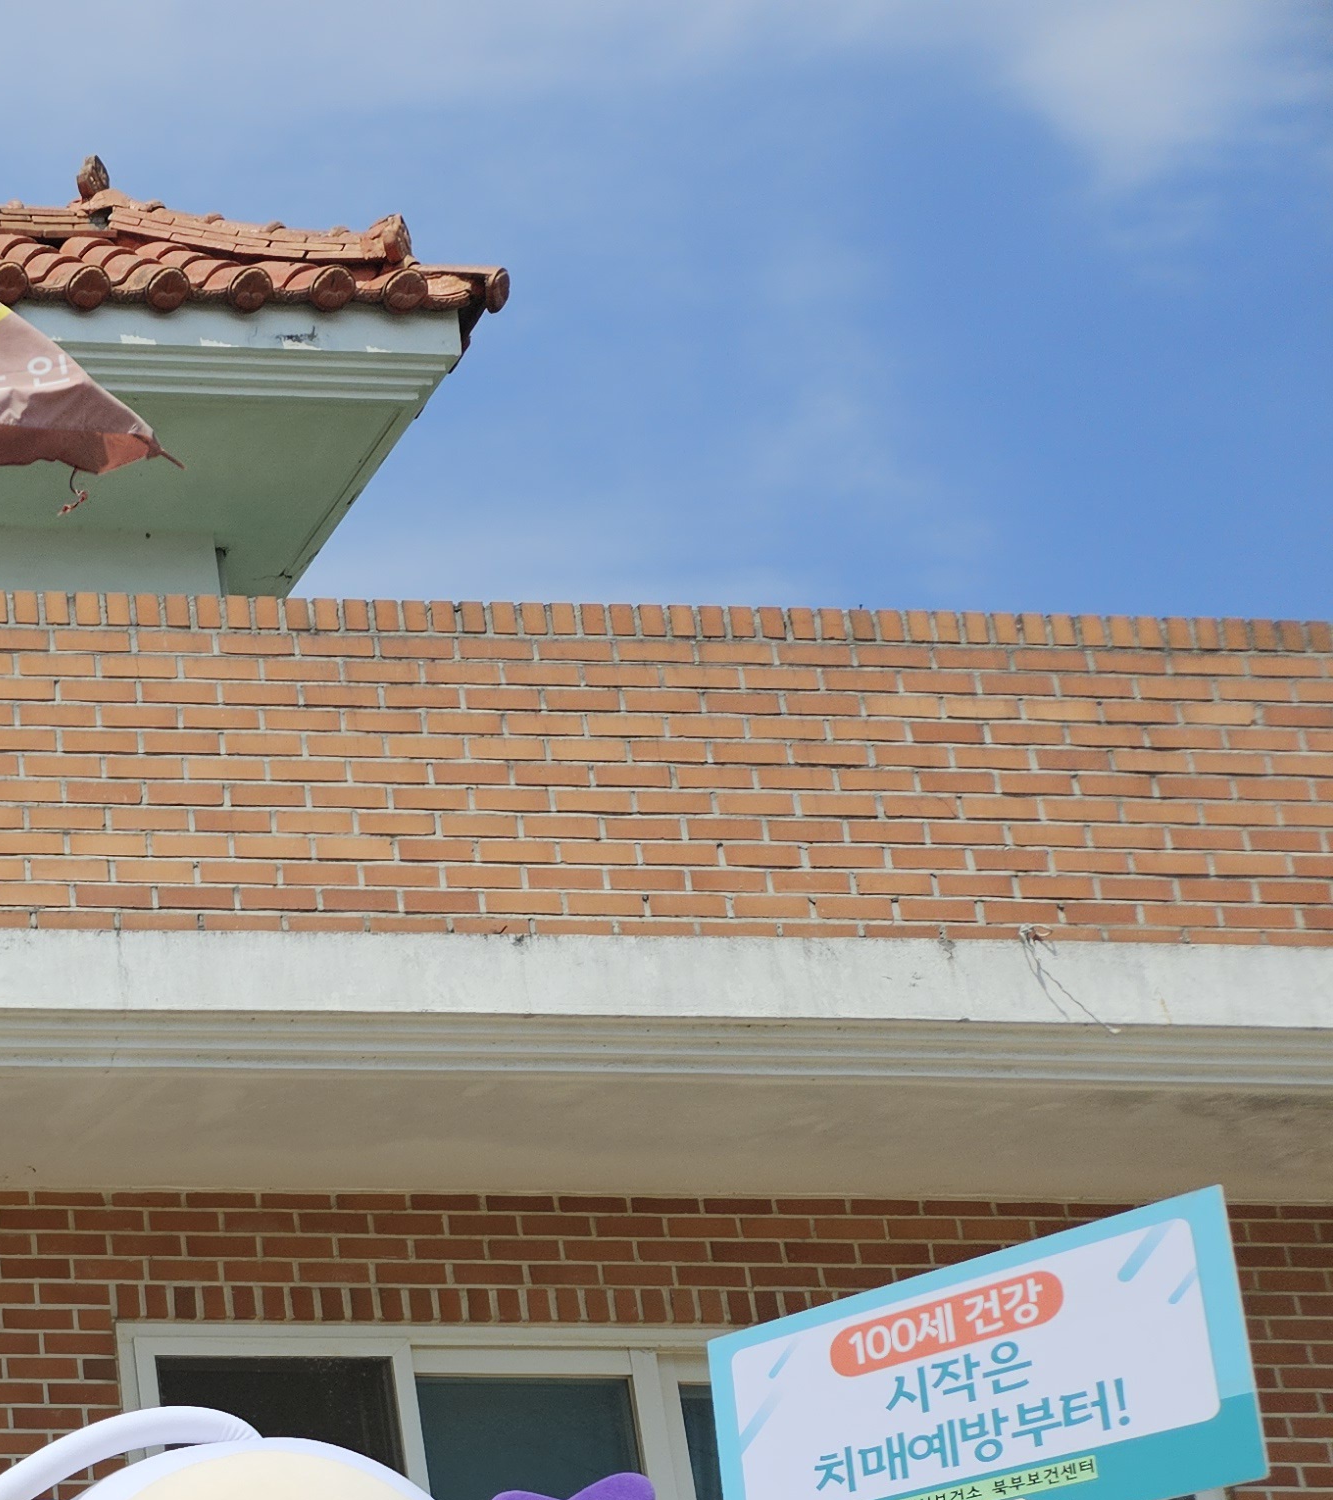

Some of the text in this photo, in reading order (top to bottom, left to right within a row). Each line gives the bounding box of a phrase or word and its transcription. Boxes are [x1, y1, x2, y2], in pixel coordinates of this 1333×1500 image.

[848, 1277, 1044, 1364] 100세 건강
[885, 1341, 1032, 1413] 시작은
[814, 1378, 1130, 1492] 치매예방부터!
[992, 1460, 1095, 1495] 북부보건센터
